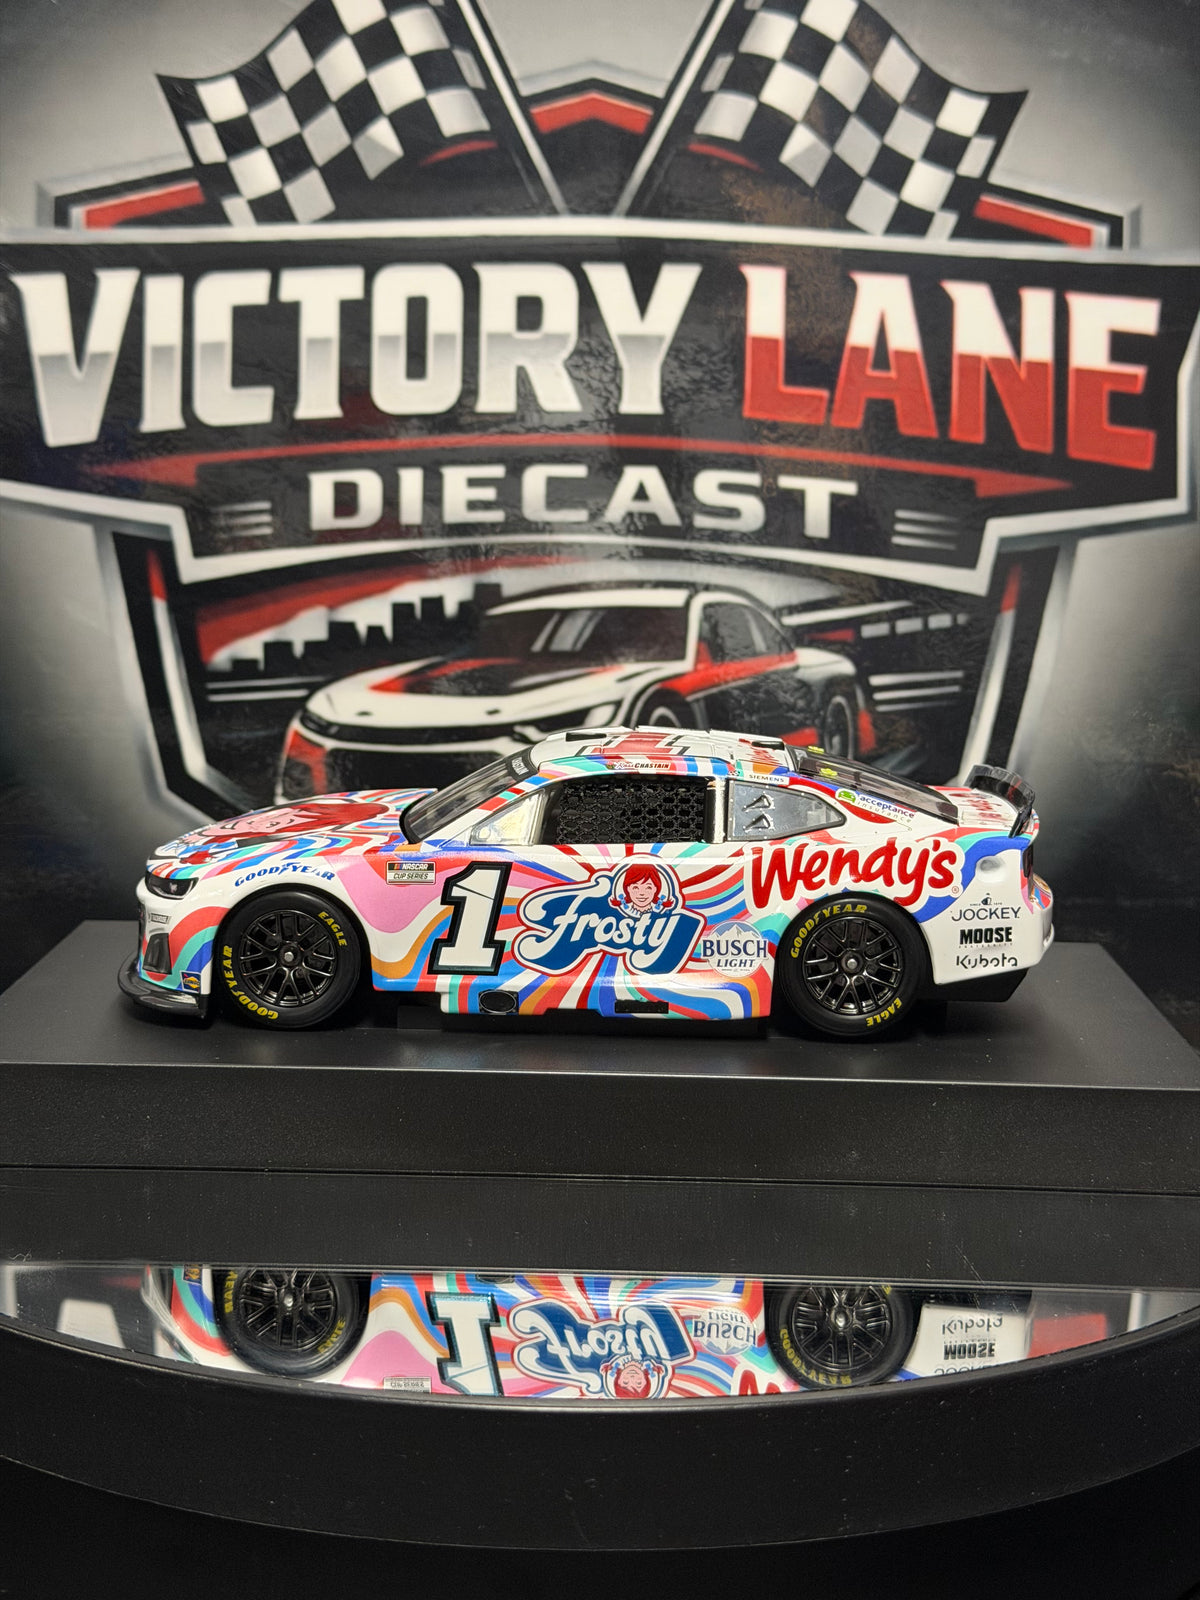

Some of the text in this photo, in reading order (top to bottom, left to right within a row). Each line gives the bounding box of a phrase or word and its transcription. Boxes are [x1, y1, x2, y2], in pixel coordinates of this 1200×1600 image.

[8, 263, 1164, 472] VICTORY LANE
[307, 463, 860, 540] DIECAST
[634, 762, 670, 770] CHASTAIN
[749, 773, 786, 783] SIEMENS
[856, 801, 913, 823] insurance
[859, 794, 916, 819] acceptance
[234, 862, 336, 888] GOODYEAR
[402, 863, 428, 871] NASCAR
[751, 838, 958, 909] Wendy's
[427, 861, 513, 975] 1
[515, 875, 684, 974] Frosty
[952, 907, 1021, 921] JOCKEY
[318, 912, 347, 946] EAGLE
[791, 903, 868, 959] GOODYEAR
[960, 927, 1012, 944] MOOSE
[702, 939, 767, 958] BUSCH
[956, 953, 1018, 969] Kubota
[716, 958, 756, 968] LIGHT
[223, 946, 279, 1019] GOODYEAR
[866, 997, 902, 1027] EAGLE
